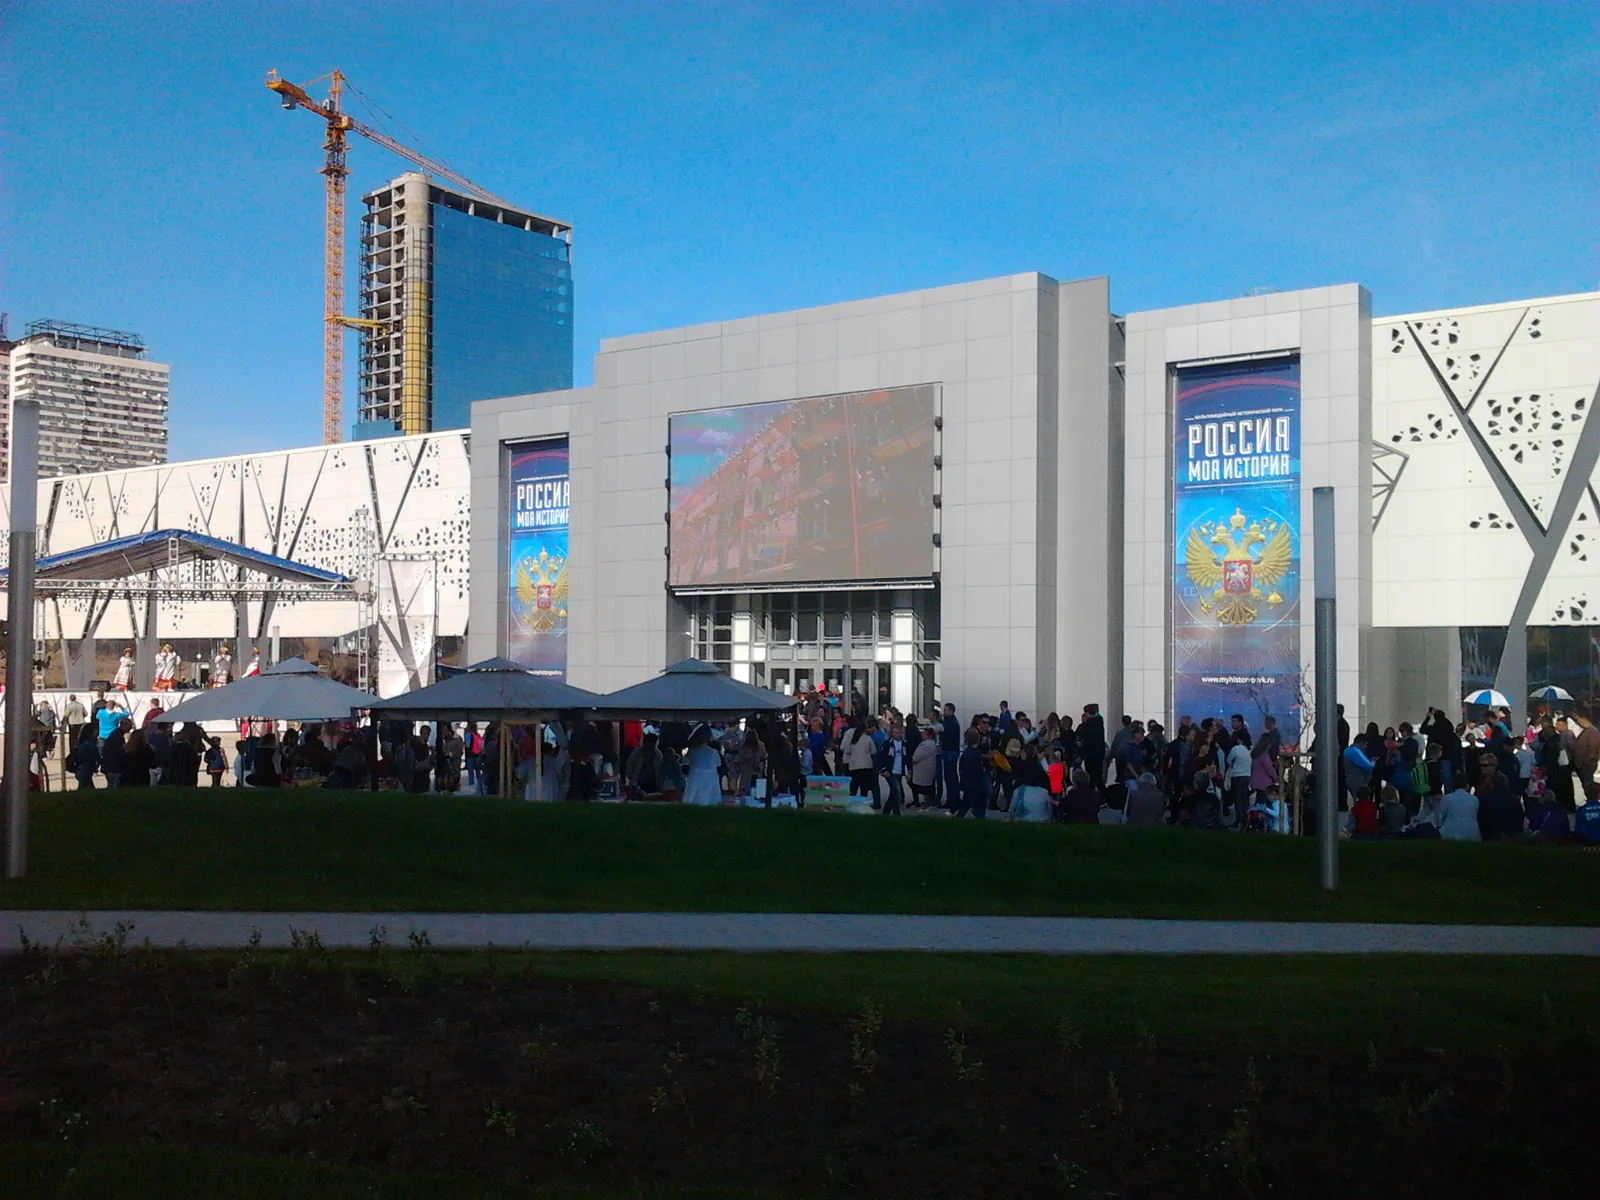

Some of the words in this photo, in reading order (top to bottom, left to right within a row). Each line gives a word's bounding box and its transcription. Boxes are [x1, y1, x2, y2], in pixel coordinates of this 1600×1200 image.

[1188, 416, 1290, 459] РОССИЯ
[1188, 459, 1220, 482] МОЯ
[1223, 454, 1290, 480] ИСТОРИЯ
[517, 481, 570, 511] РОССИЯ
[517, 510, 535, 528] МОЯ
